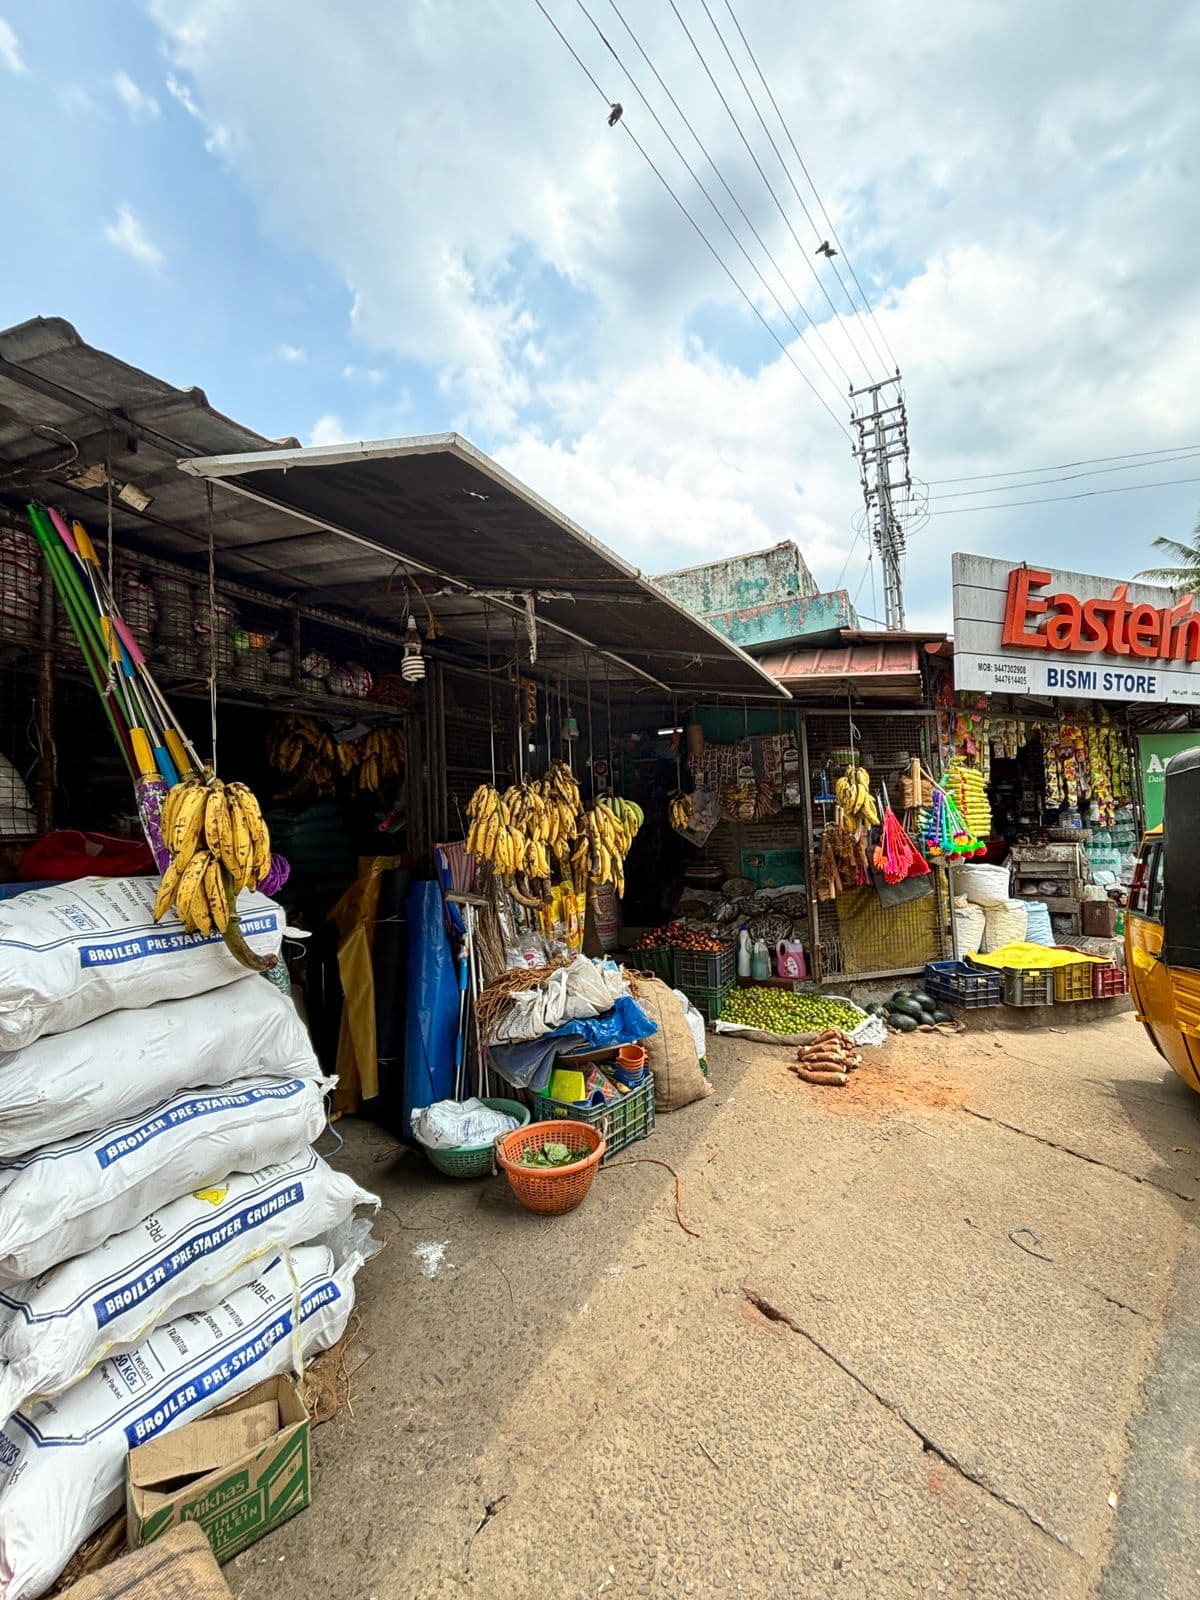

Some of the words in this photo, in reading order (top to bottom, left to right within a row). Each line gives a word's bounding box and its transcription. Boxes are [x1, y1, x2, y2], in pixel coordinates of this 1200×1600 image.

[1002, 568, 1200, 662] Eastern
[1047, 668, 1097, 690] BISMI
[1103, 672, 1157, 694] STORE
[88, 942, 142, 962] BROILER
[105, 1118, 167, 1160] BROILER
[170, 1094, 250, 1122] PRE-STARTER
[252, 1082, 299, 1099] CRUMBLE
[105, 1266, 167, 1316] BROILER
[171, 1217, 242, 1270] PRE-STARTER
[246, 1187, 298, 1225] CRUMBLE
[166, 1327, 189, 1356] TRADITION
[204, 1315, 224, 1340] SOURCED
[121, 1365, 138, 1386] KGs
[134, 1355, 154, 1382] WEIGHT
[134, 1385, 198, 1440] BROILER
[201, 1322, 285, 1391] PRE-STARTER
